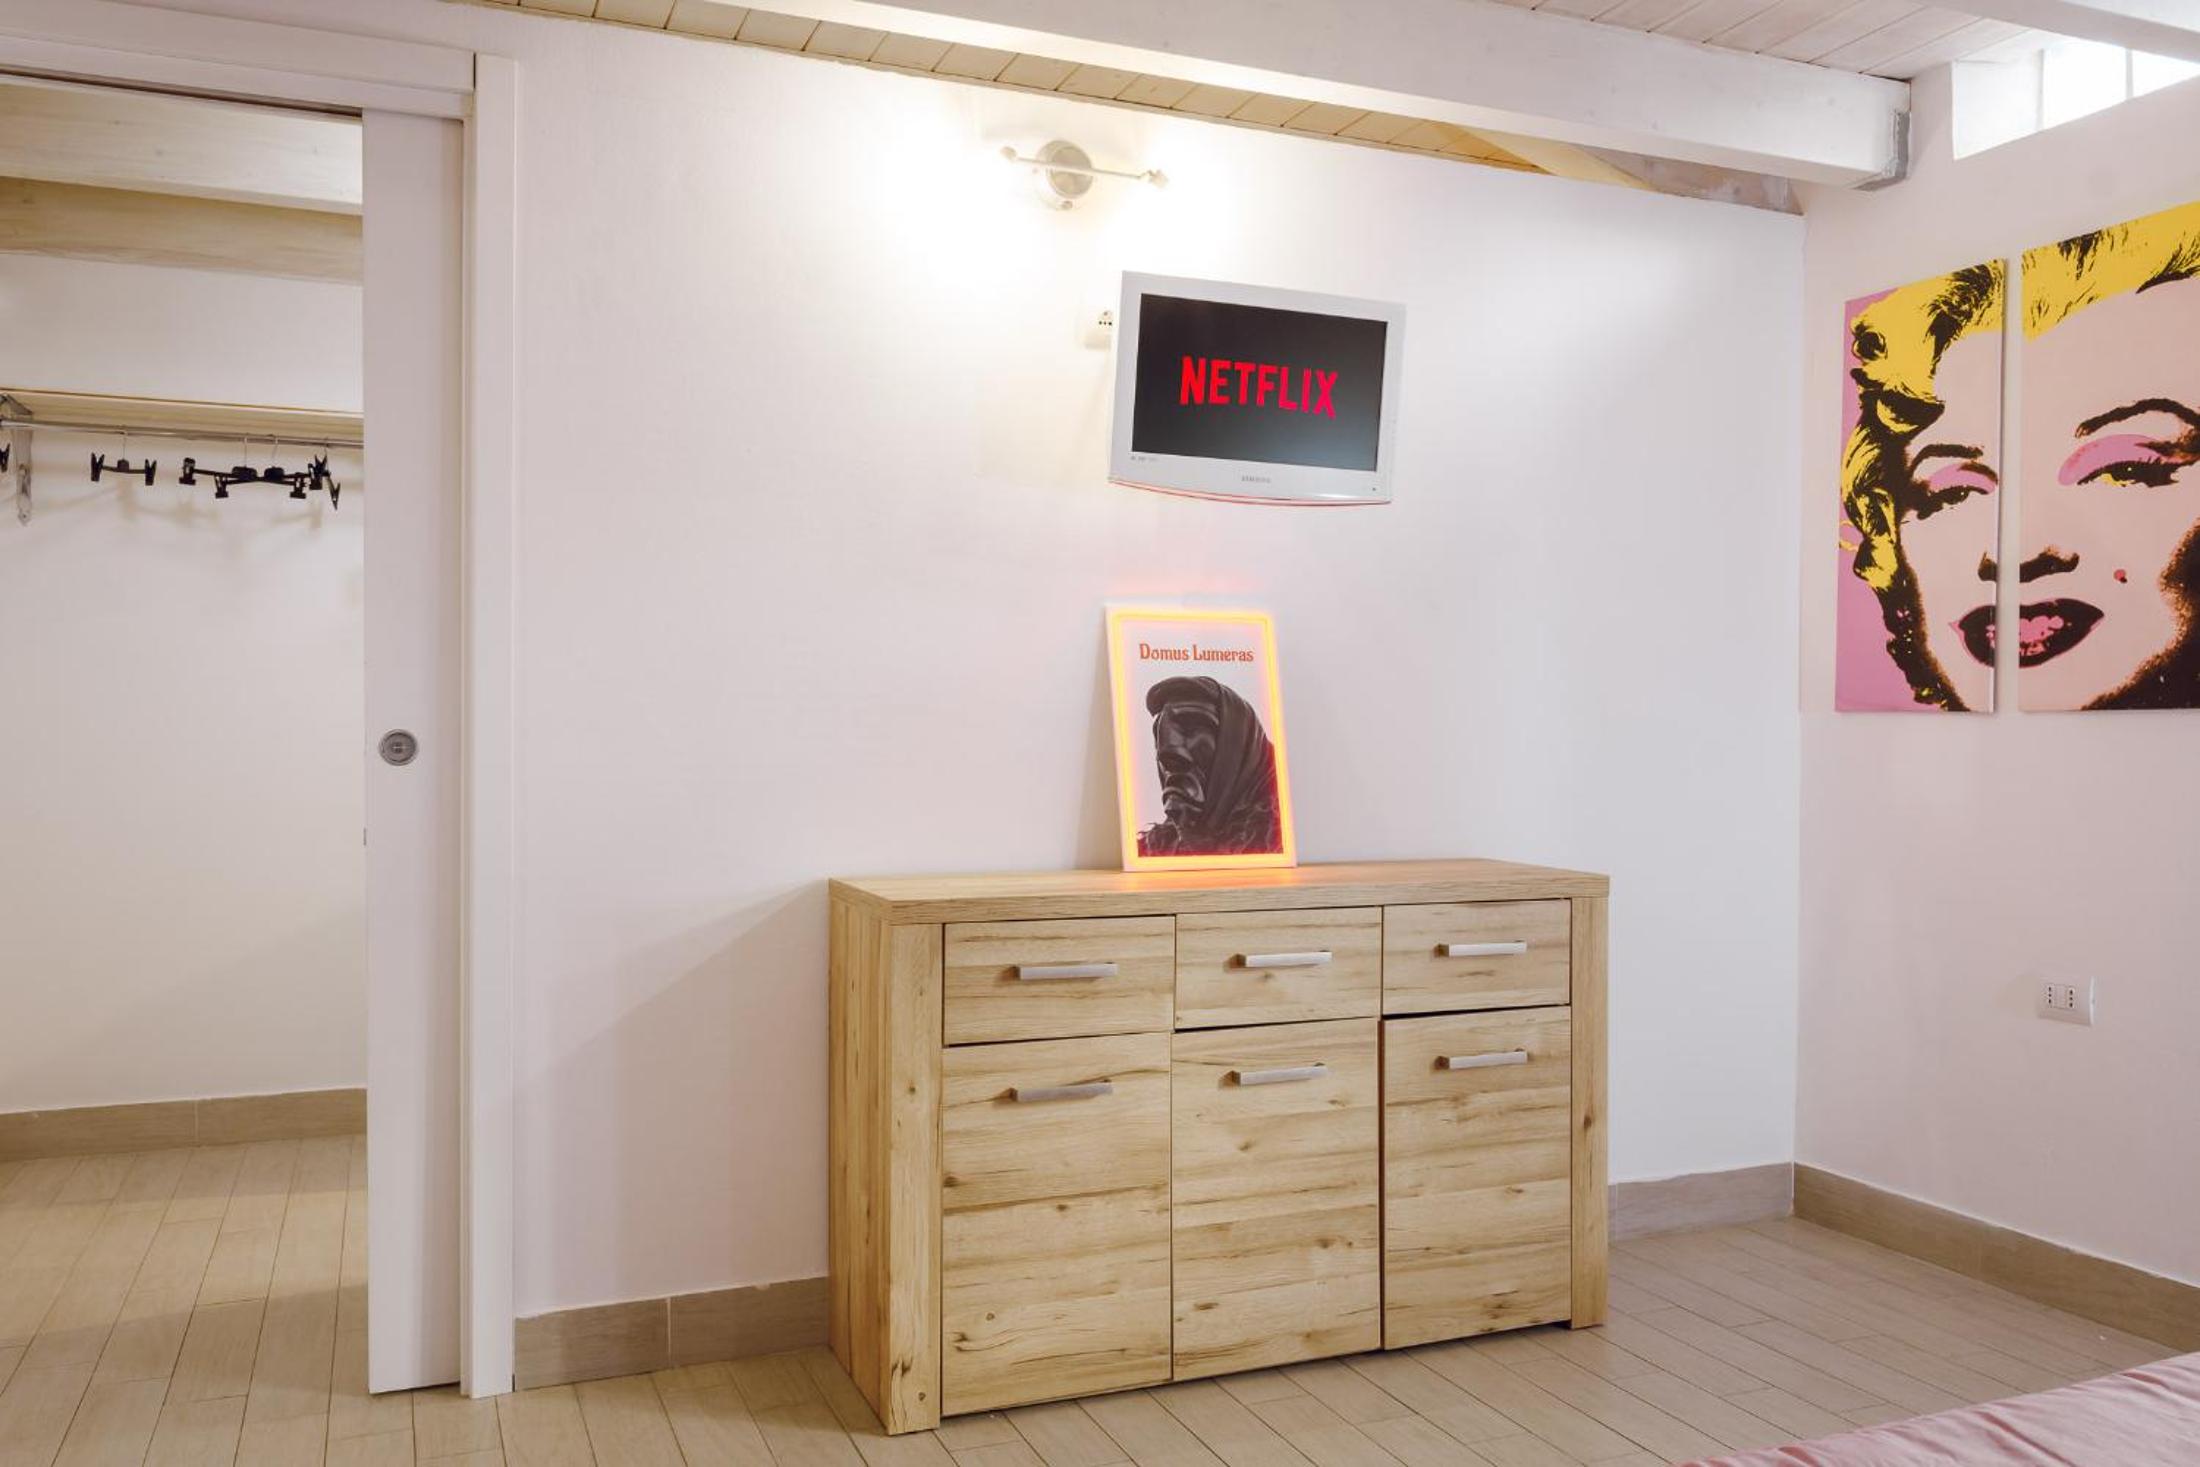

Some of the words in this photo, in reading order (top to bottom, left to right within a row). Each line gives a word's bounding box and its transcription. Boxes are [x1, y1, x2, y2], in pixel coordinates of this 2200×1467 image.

[1180, 356, 1338, 418] NETFLIX
[1139, 643, 1189, 660] Domus
[1192, 644, 1254, 662] Lumeras
